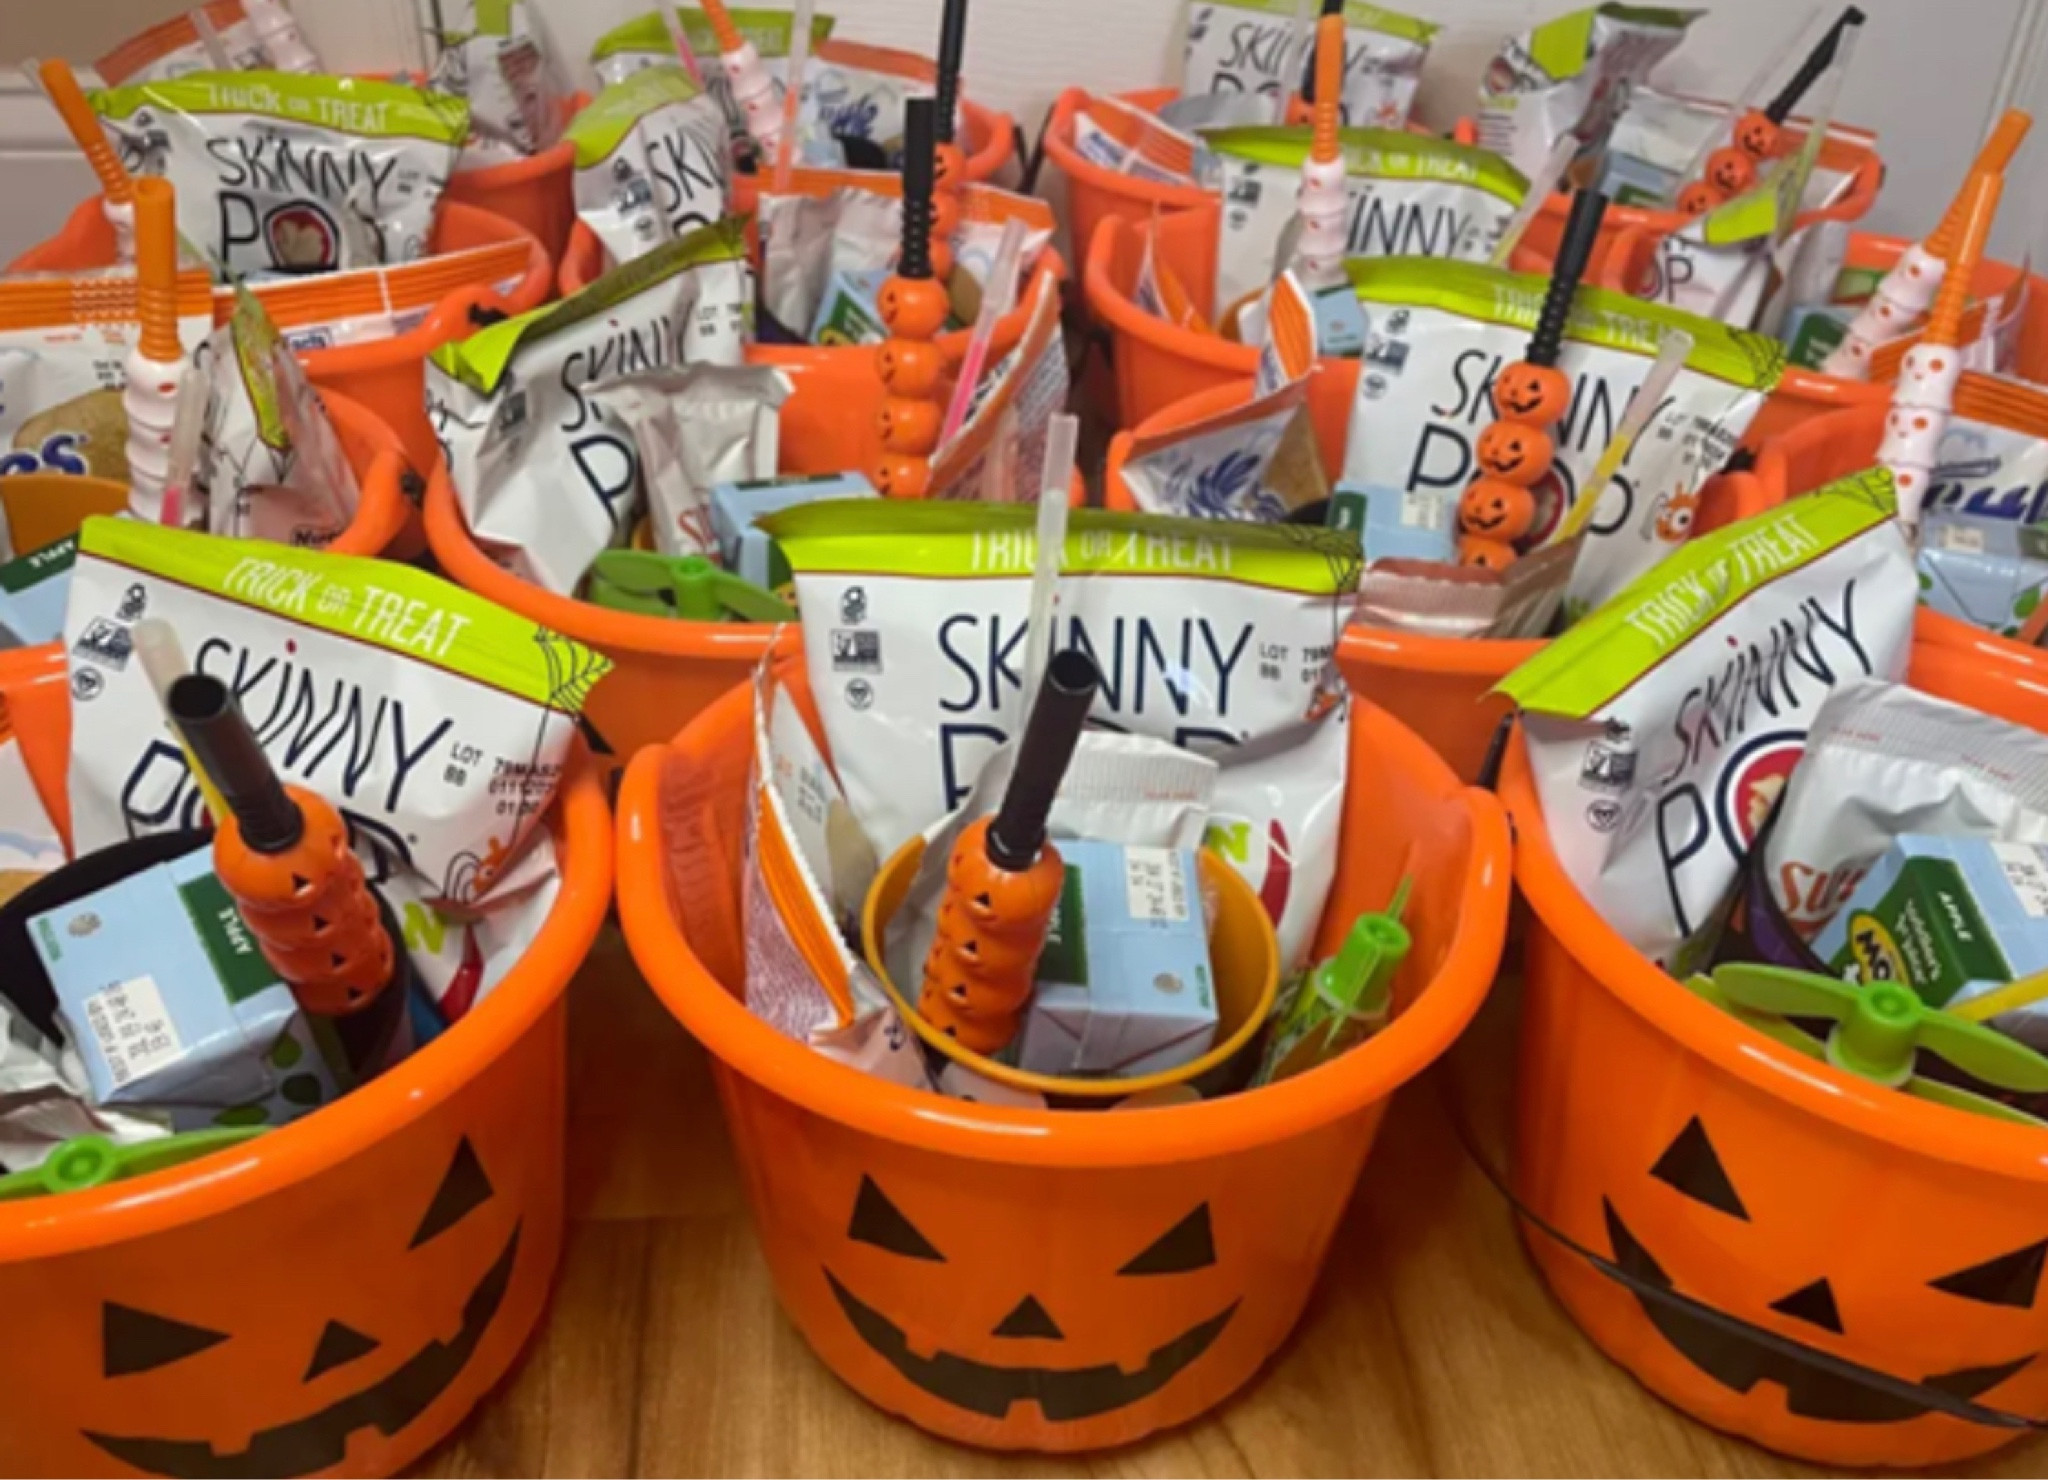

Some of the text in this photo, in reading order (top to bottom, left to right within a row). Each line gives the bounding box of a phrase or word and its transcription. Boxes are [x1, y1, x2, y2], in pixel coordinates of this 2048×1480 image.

[223, 555, 474, 659] TRICK OR TREAT
[1625, 568, 1719, 649] TRICK
[450, 740, 484, 767] LOT
[1936, 889, 1974, 943] APPLE
